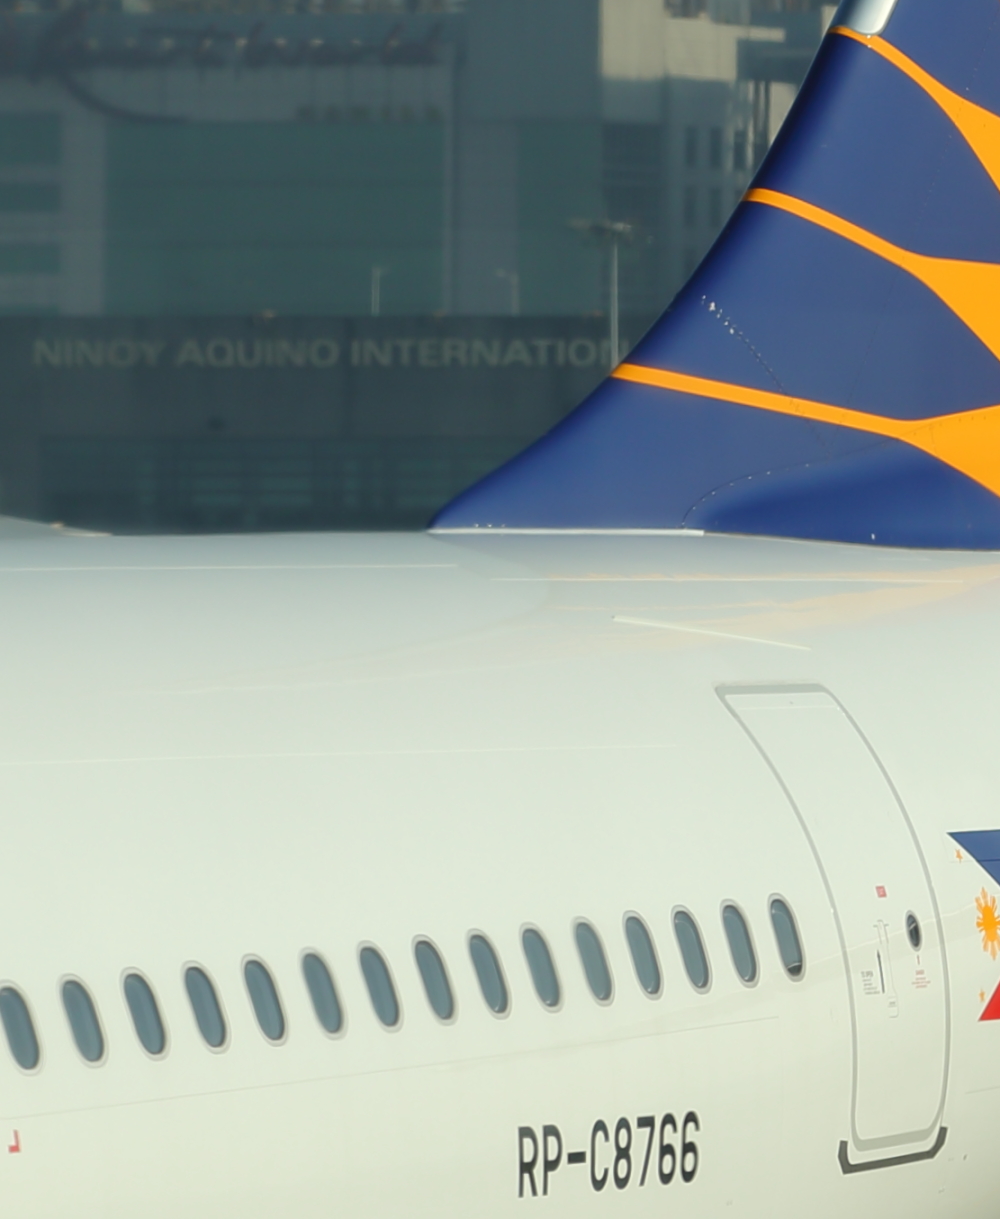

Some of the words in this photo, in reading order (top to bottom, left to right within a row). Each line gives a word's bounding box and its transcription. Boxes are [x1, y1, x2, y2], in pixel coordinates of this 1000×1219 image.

[32, 338, 167, 368] NINOY
[174, 338, 339, 368] AQUINO
[518, 1110, 700, 1198] RP-C8766
